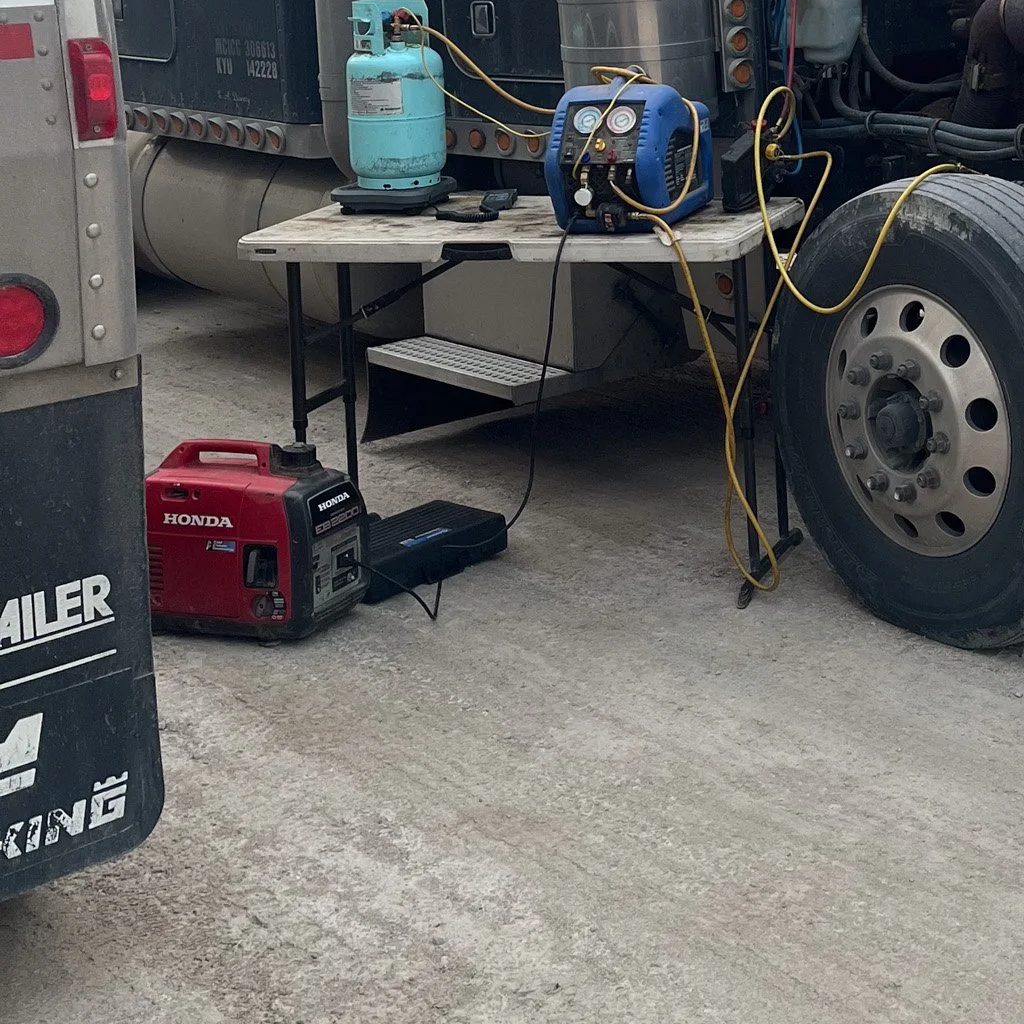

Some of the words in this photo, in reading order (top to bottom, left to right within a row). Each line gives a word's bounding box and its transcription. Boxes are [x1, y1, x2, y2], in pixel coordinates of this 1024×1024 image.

[216, 57, 233, 75] KYU
[246, 60, 278, 79] 142228
[318, 492, 350, 512] HONDA
[163, 513, 234, 528] HONDA
